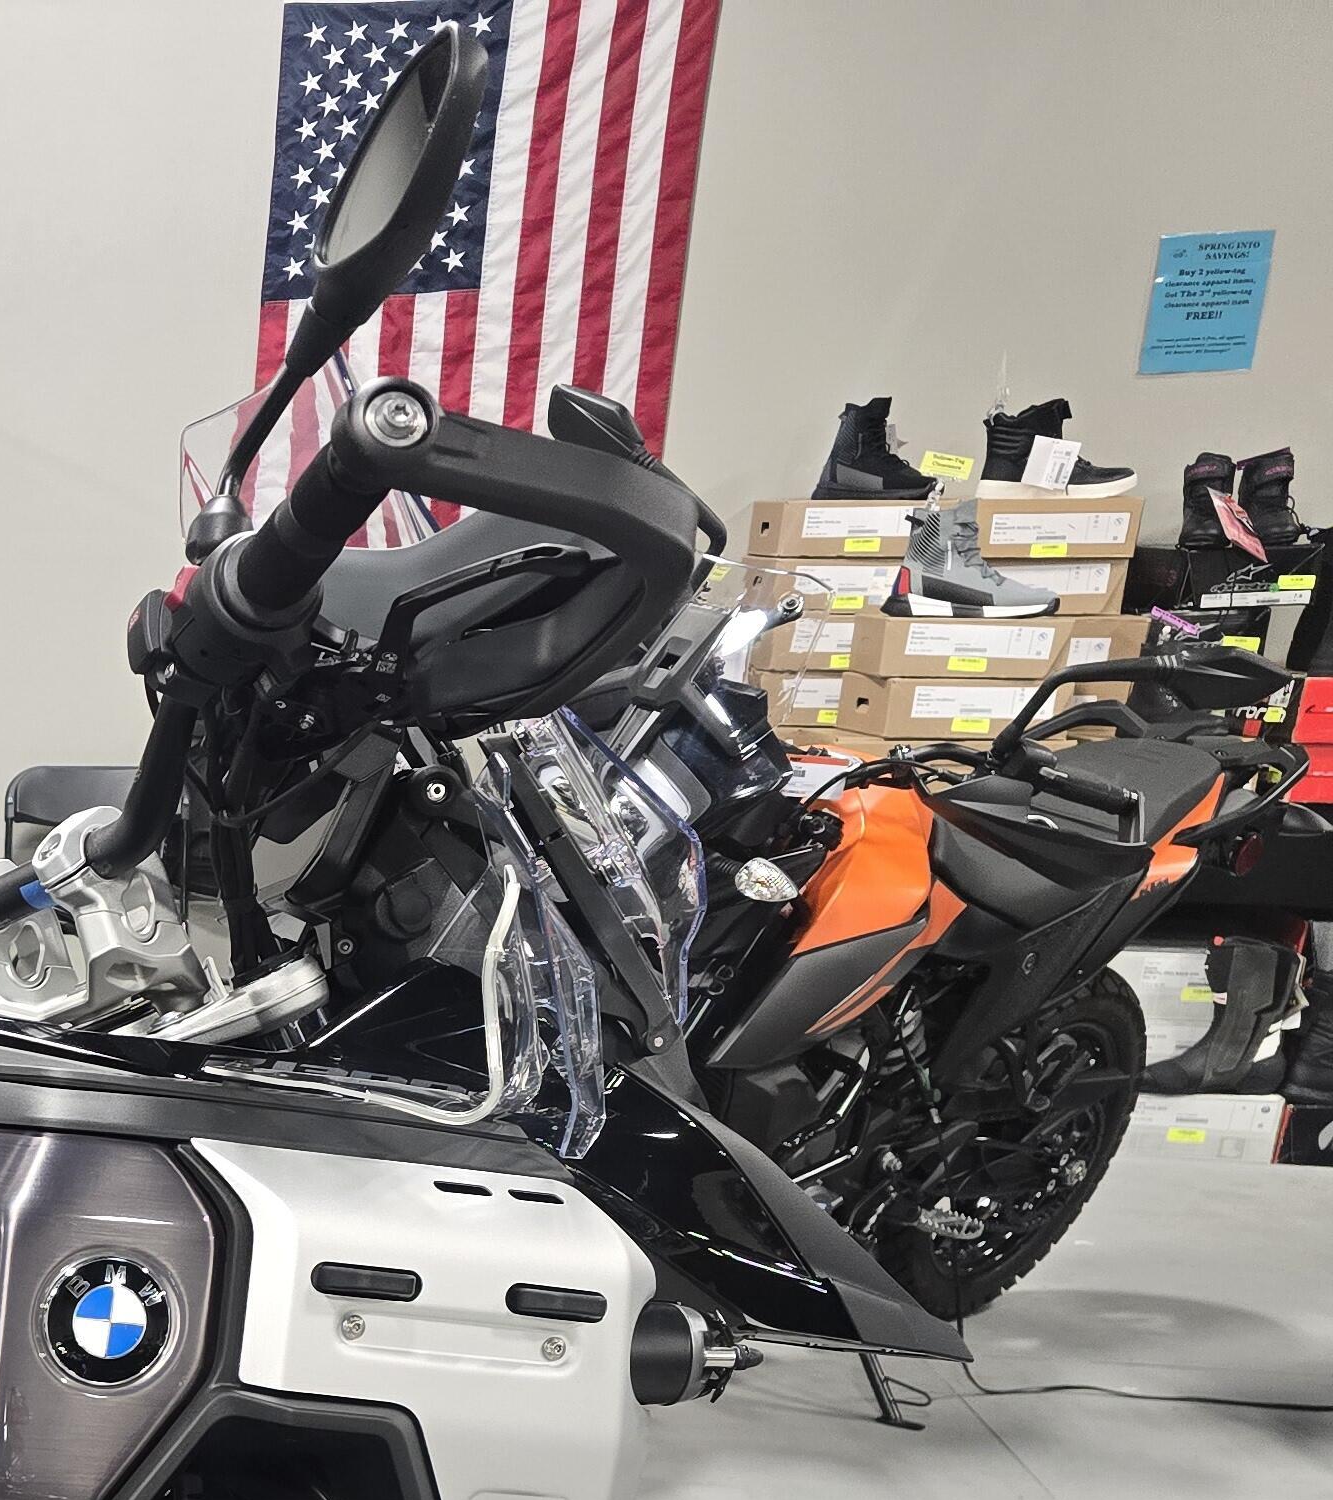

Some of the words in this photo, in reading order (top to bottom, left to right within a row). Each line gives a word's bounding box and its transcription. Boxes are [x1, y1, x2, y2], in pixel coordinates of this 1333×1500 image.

[1198, 241, 1235, 251] SPRING
[1237, 241, 1261, 249] INTO
[1205, 251, 1250, 260] SAVINGS!
[1179, 269, 1196, 277] Buy
[1185, 310, 1223, 321] FREE!!
[64, 1264, 166, 1306] BMW
